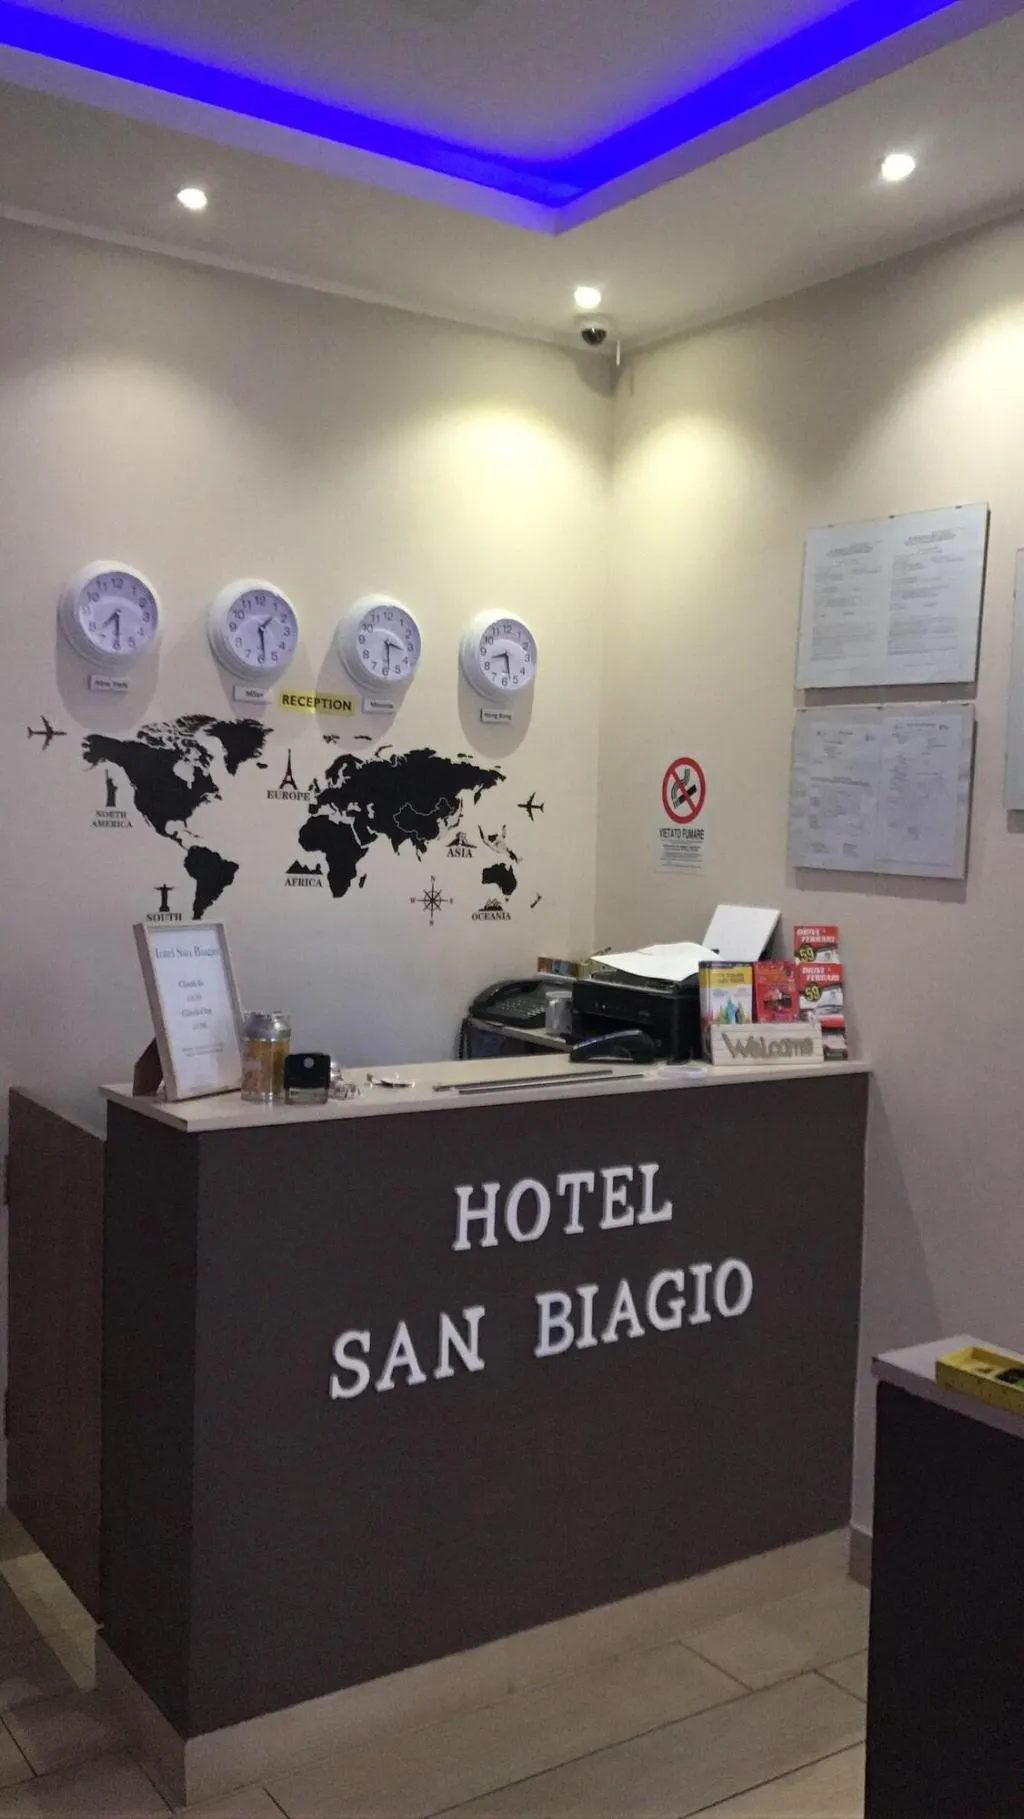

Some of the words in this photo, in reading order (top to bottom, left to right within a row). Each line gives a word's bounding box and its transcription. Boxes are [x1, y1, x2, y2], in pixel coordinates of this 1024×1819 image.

[242, 599, 252, 609] 11
[254, 596, 266, 606] 12
[233, 609, 245, 620] 10
[281, 614, 287, 623] 2
[371, 614, 380, 624] 11
[383, 611, 394, 621] 12
[229, 622, 237, 632] 9
[284, 627, 290, 636] 3
[363, 624, 373, 633] 10
[492, 627, 500, 636] 11
[503, 624, 512, 634] 12
[405, 630, 412, 639] 2
[235, 637, 242, 648] 8
[359, 635, 366, 645] 9
[485, 636, 494, 645] 10
[279, 641, 285, 650] 4
[408, 643, 413, 652] 3
[523, 642, 528, 651] 2
[246, 649, 251, 658] 7
[271, 651, 278, 662] 5
[362, 649, 370, 659] 8
[480, 647, 487, 656] 9
[257, 655, 265, 664] 6
[402, 657, 409, 665] 4
[525, 654, 530, 662] 3
[371, 661, 377, 670] 7
[395, 664, 401, 675] 5
[484, 661, 490, 670] 8
[382, 667, 389, 677] 6
[520, 667, 525, 675] 4
[491, 672, 497, 681] 7
[502, 677, 508, 686] 6
[513, 675, 519, 685] 5
[282, 695, 352, 711] RECEPTION
[267, 790, 311, 801] EUROPE
[96, 810, 127, 818] NORTH
[91, 819, 133, 829] AMERICA
[659, 828, 682, 838] VIETATO
[682, 829, 704, 840] FUMARE
[447, 848, 473, 858] ASIA
[285, 877, 323, 888] AFRICA
[146, 912, 182, 922] SOUTH
[472, 912, 511, 920] OCEANIA
[800, 947, 815, 961] 59
[805, 987, 819, 1001] 59
[721, 1032, 815, 1059] Welcome
[451, 1162, 673, 1251] HOTEL
[329, 1305, 486, 1400] SAN
[533, 1257, 754, 1358] BIAGIO
